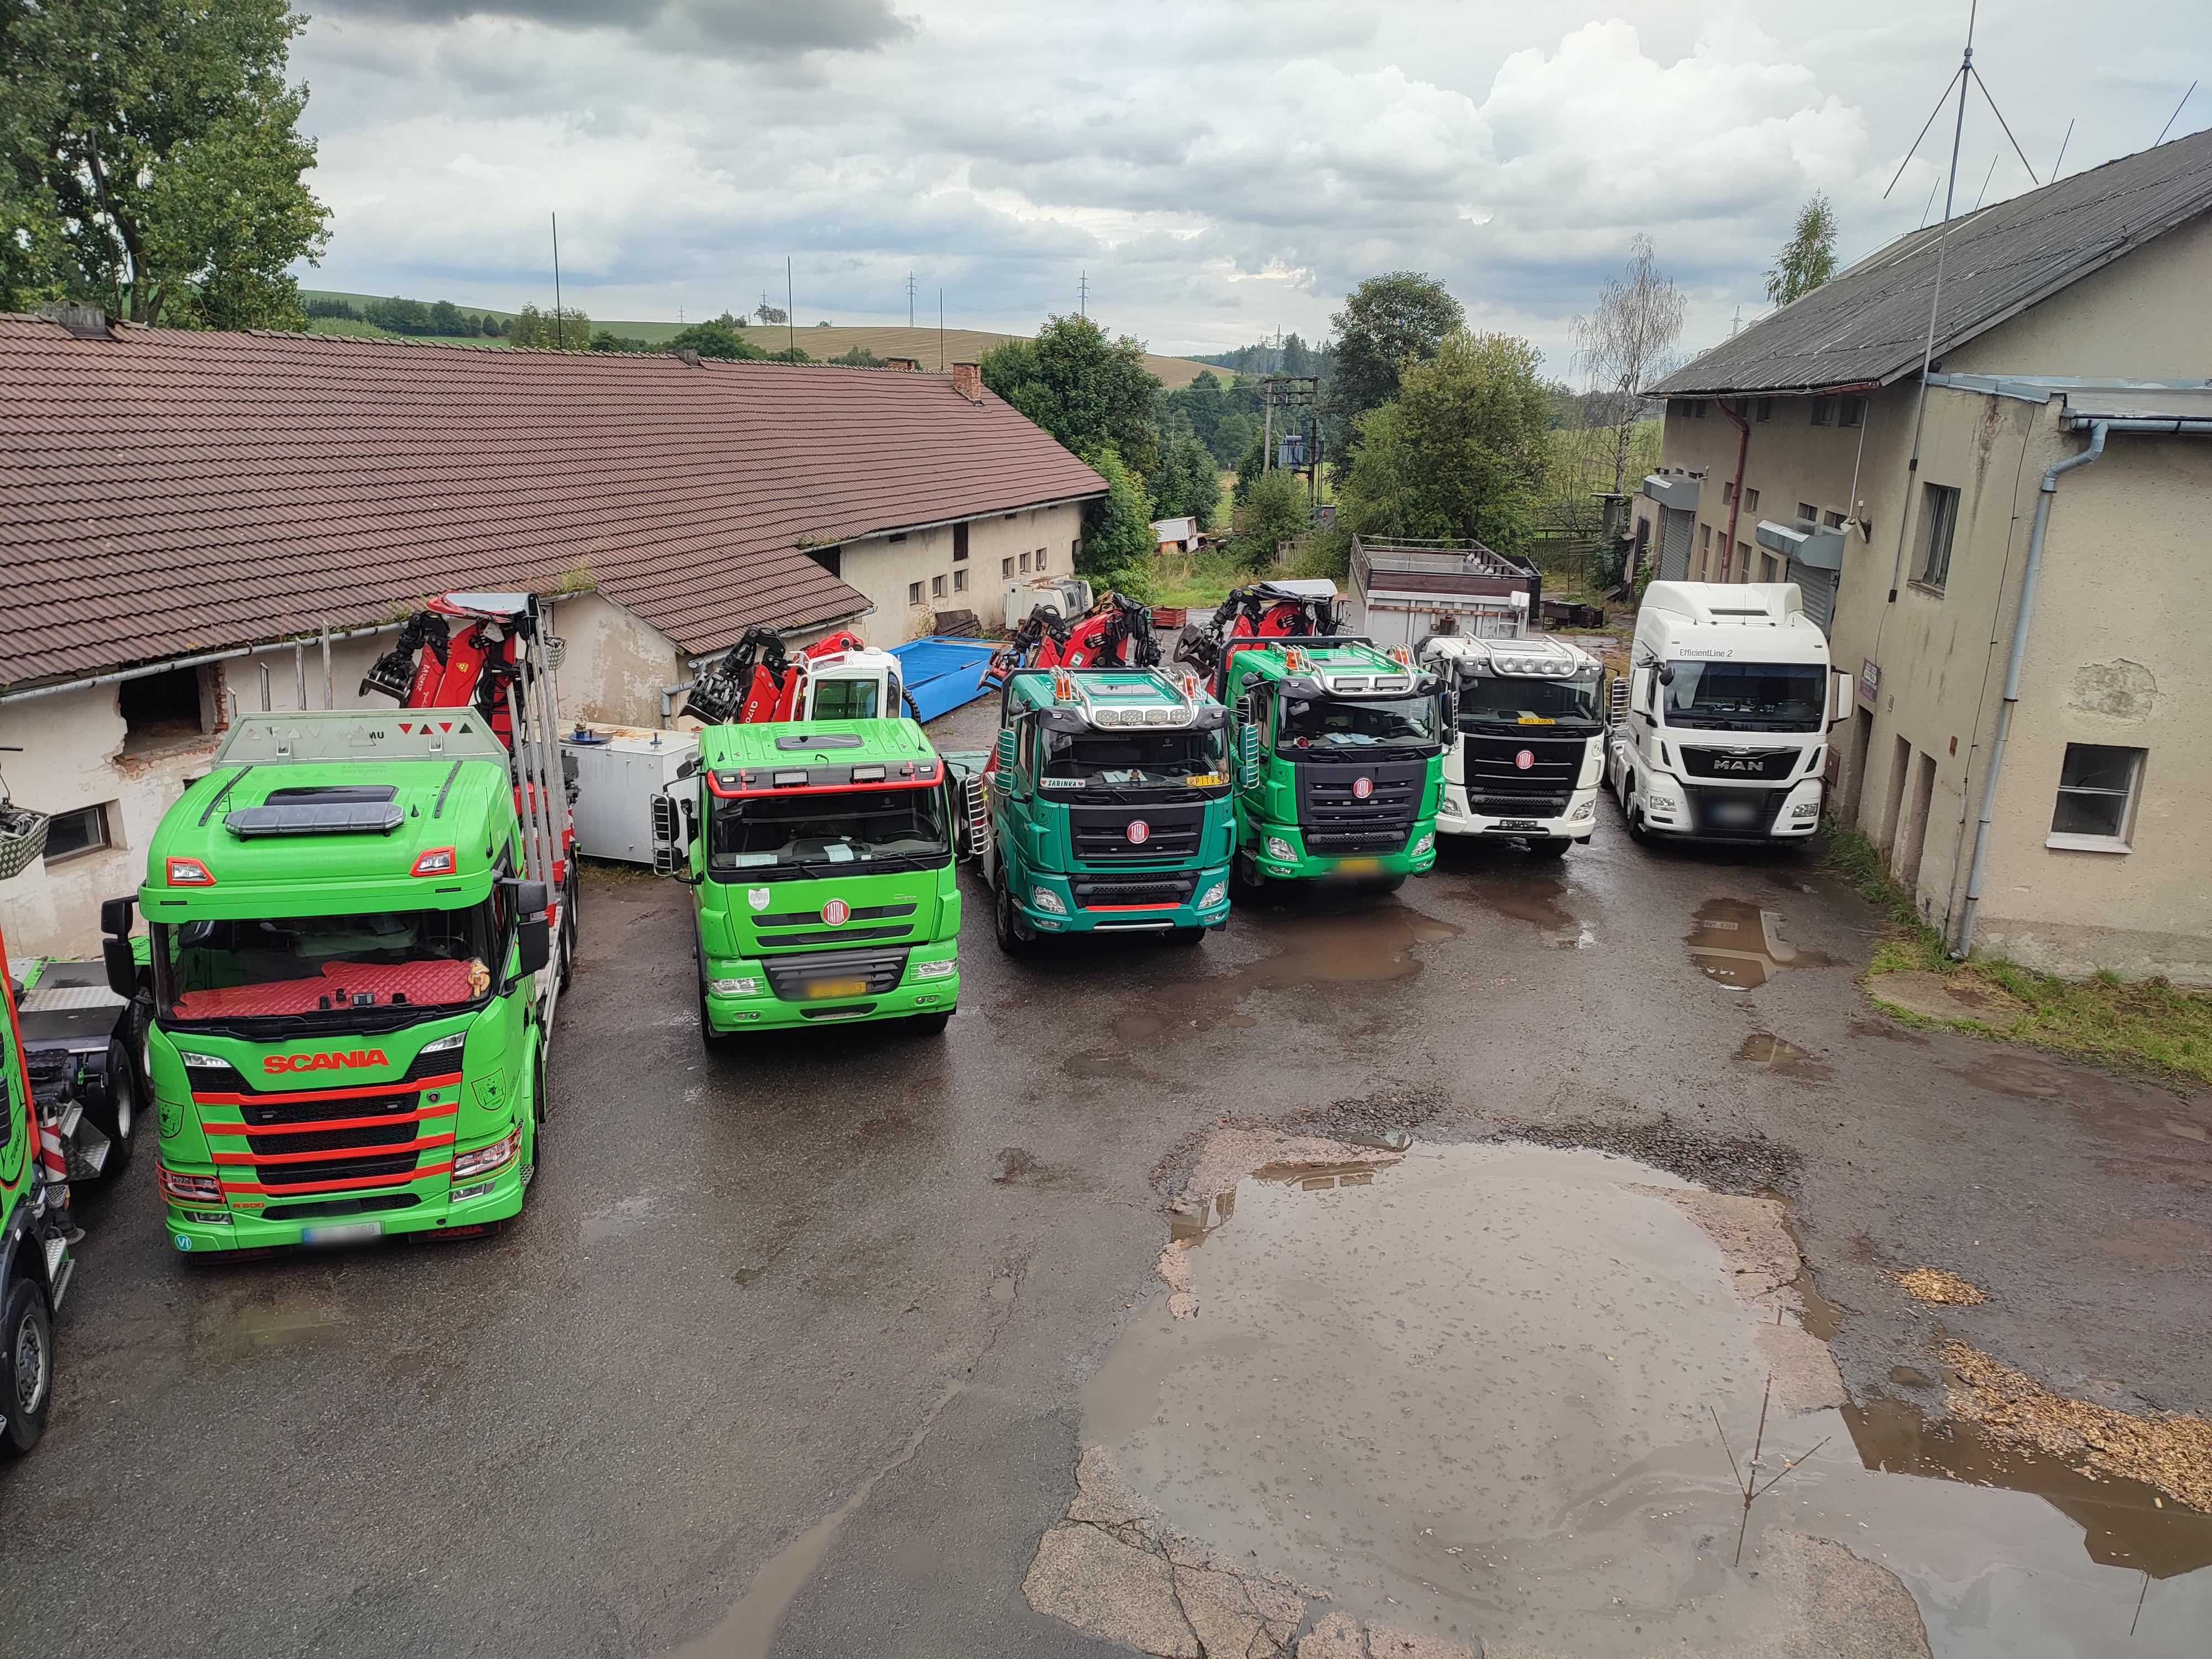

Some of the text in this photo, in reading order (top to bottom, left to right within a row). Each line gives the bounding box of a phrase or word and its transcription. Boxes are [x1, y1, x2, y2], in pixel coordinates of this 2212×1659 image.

[1679, 649, 1733, 658] EfficientLine 2
[1519, 753, 1531, 767] TATRA
[1714, 760, 1764, 771] MAN
[1357, 780, 1369, 796] TATRA
[1131, 823, 1145, 842] TATRA
[827, 902, 844, 924] TATRA
[263, 1048, 390, 1074] SCANIA
[426, 1224, 483, 1238] SCANIA
[177, 1237, 189, 1248] VI
